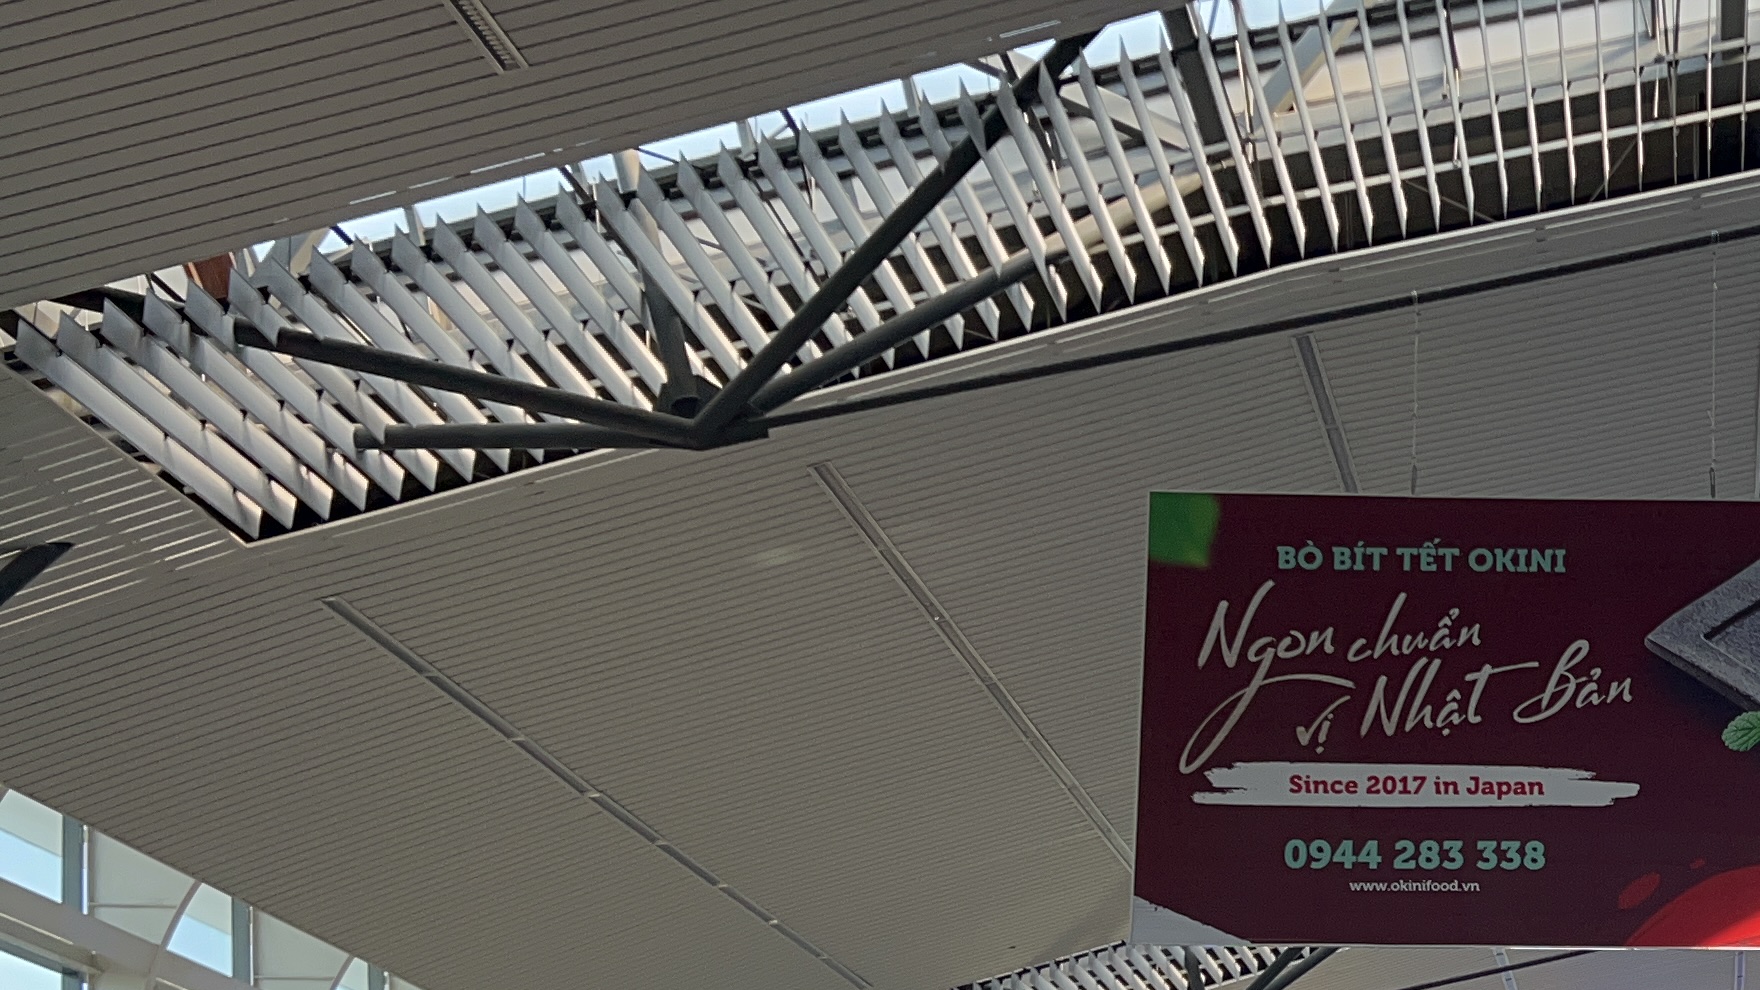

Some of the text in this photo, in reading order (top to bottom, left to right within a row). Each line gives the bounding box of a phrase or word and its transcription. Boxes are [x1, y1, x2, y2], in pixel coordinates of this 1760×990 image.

[1277, 538, 1567, 573] BÒ BÍT TẾT OKINI
[1347, 592, 1481, 662] chuẩn
[1296, 640, 1632, 754] vị Nhật Bản
[1288, 774, 1545, 801] Since 2017 in Japan
[1284, 839, 1546, 870] 0944 283 338
[1349, 879, 1481, 893] www.okinifood.vn
